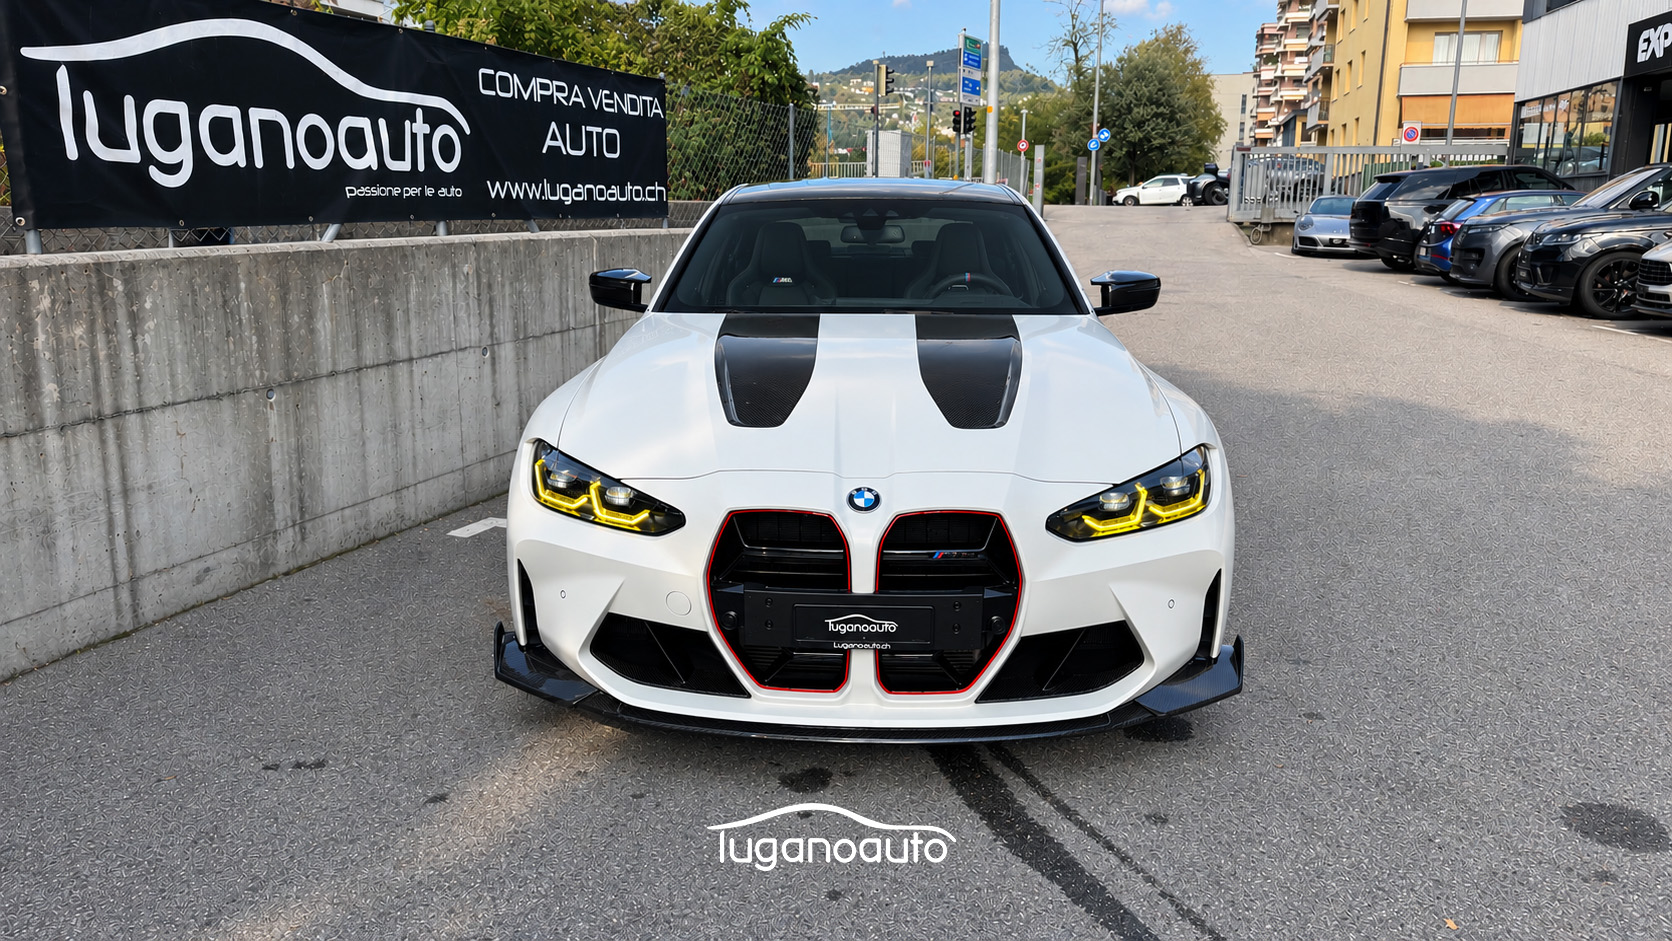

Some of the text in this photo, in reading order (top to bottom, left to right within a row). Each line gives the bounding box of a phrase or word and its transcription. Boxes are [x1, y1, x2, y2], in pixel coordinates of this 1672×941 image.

[478, 67, 664, 119] COMPRA VENDITA
[56, 64, 462, 188] luganoauto
[542, 121, 621, 159] AUTO
[345, 184, 463, 199] passione per le auto
